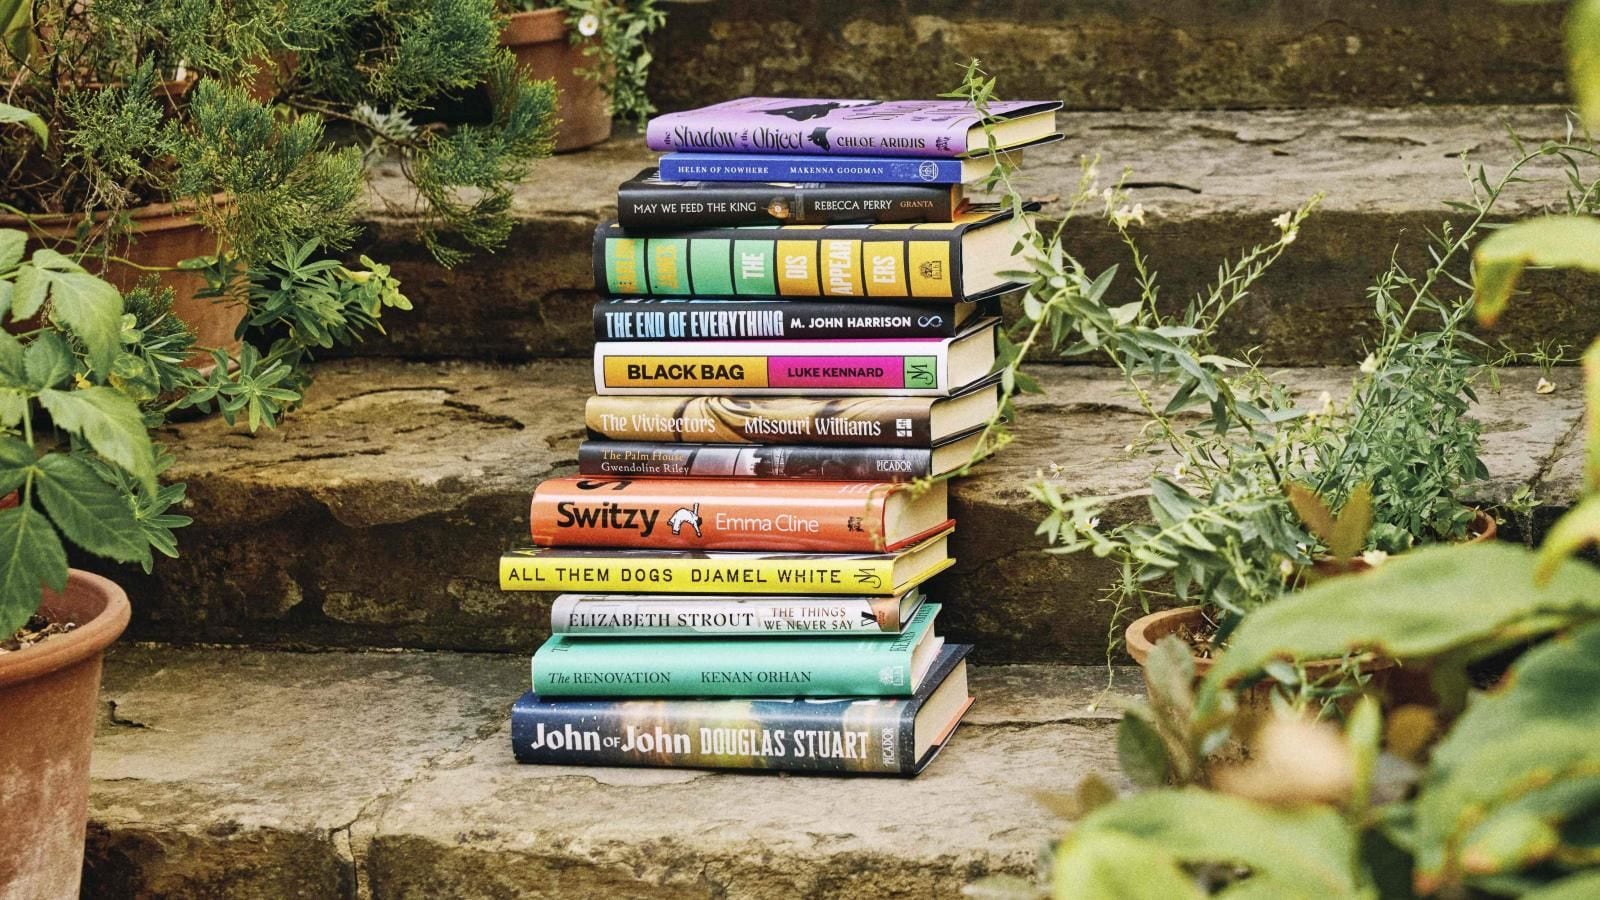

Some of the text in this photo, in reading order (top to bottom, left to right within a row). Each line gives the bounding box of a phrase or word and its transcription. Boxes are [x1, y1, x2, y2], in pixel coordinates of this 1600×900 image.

[674, 125, 737, 149] Shadow
[837, 136, 926, 149] CHLOE ARIDJIS
[678, 166, 769, 174] HELEN OF NOWHERE
[790, 166, 884, 175] MAKENNA GOODMAN
[634, 201, 757, 214] MAY WE FEED THE KING
[814, 199, 892, 211] REBECCA PERRY
[900, 200, 934, 208] GRANTA
[742, 252, 765, 279] THE
[784, 255, 809, 280] DIS
[828, 240, 854, 295] APPEAR
[872, 255, 896, 284] ERS
[605, 310, 784, 338] THE END OF EVERYTHING
[790, 316, 911, 329] M. JOHN HARRISON
[627, 364, 745, 380] BLACK BAG
[788, 367, 884, 378] LUKE KENNARD
[600, 413, 716, 433] The Vivisectors
[745, 415, 882, 436] Missouri Williams
[602, 449, 684, 461] The Palm House
[601, 462, 689, 475] Gwendoline Riley
[876, 460, 912, 472] PICADOR
[557, 501, 660, 537] Switzy
[716, 512, 819, 533] Emma Cline
[508, 568, 673, 582] ALL THEM DOGS
[691, 569, 841, 583] DJAMEL WHITE
[772, 607, 846, 617] THE THINGS
[569, 612, 754, 627] ELIZABETH STROUT
[764, 620, 853, 630] WE NEVER SAY
[548, 672, 671, 684] The RENOVATION
[701, 671, 812, 683] KENAN ORHAN
[531, 723, 691, 754] John OF John
[700, 728, 869, 759] DOUGLAS STUART
[881, 727, 896, 768] PICADOR
